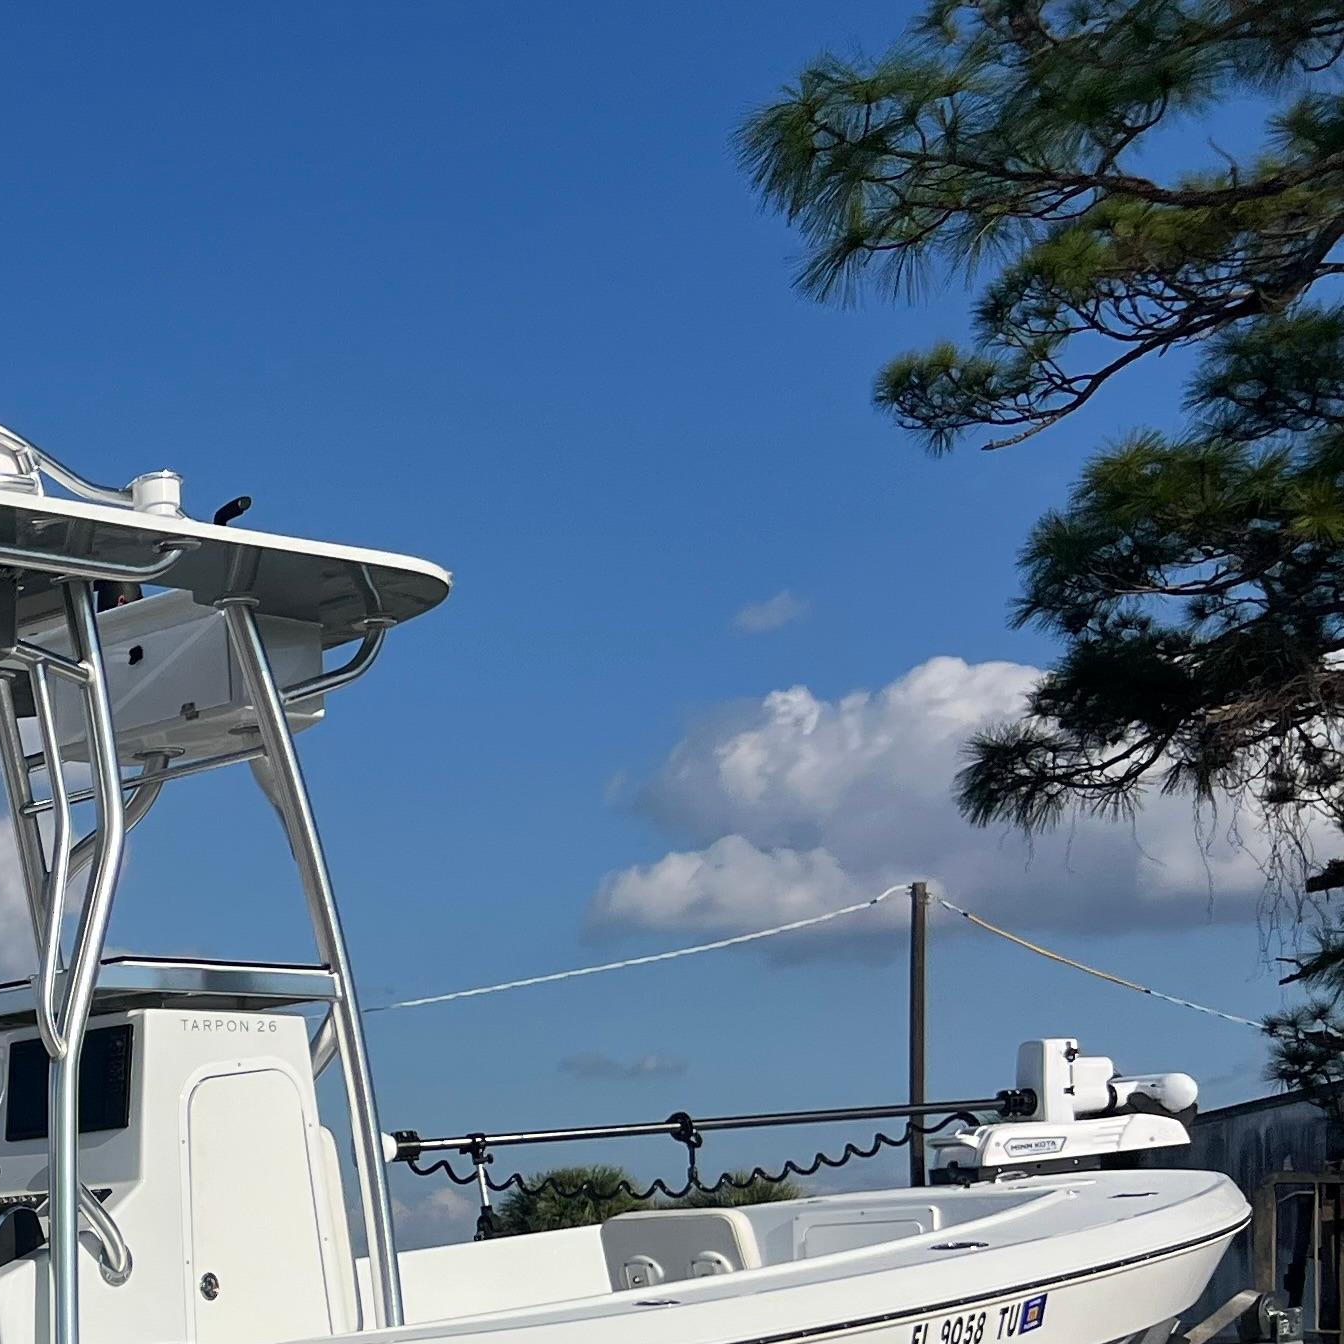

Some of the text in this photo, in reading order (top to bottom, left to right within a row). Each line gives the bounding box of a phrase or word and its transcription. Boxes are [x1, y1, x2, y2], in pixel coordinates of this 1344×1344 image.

[180, 1019, 277, 1033] TARPON 26
[1035, 1140, 1056, 1148] KOTA
[997, 1303, 1021, 1340] TU
